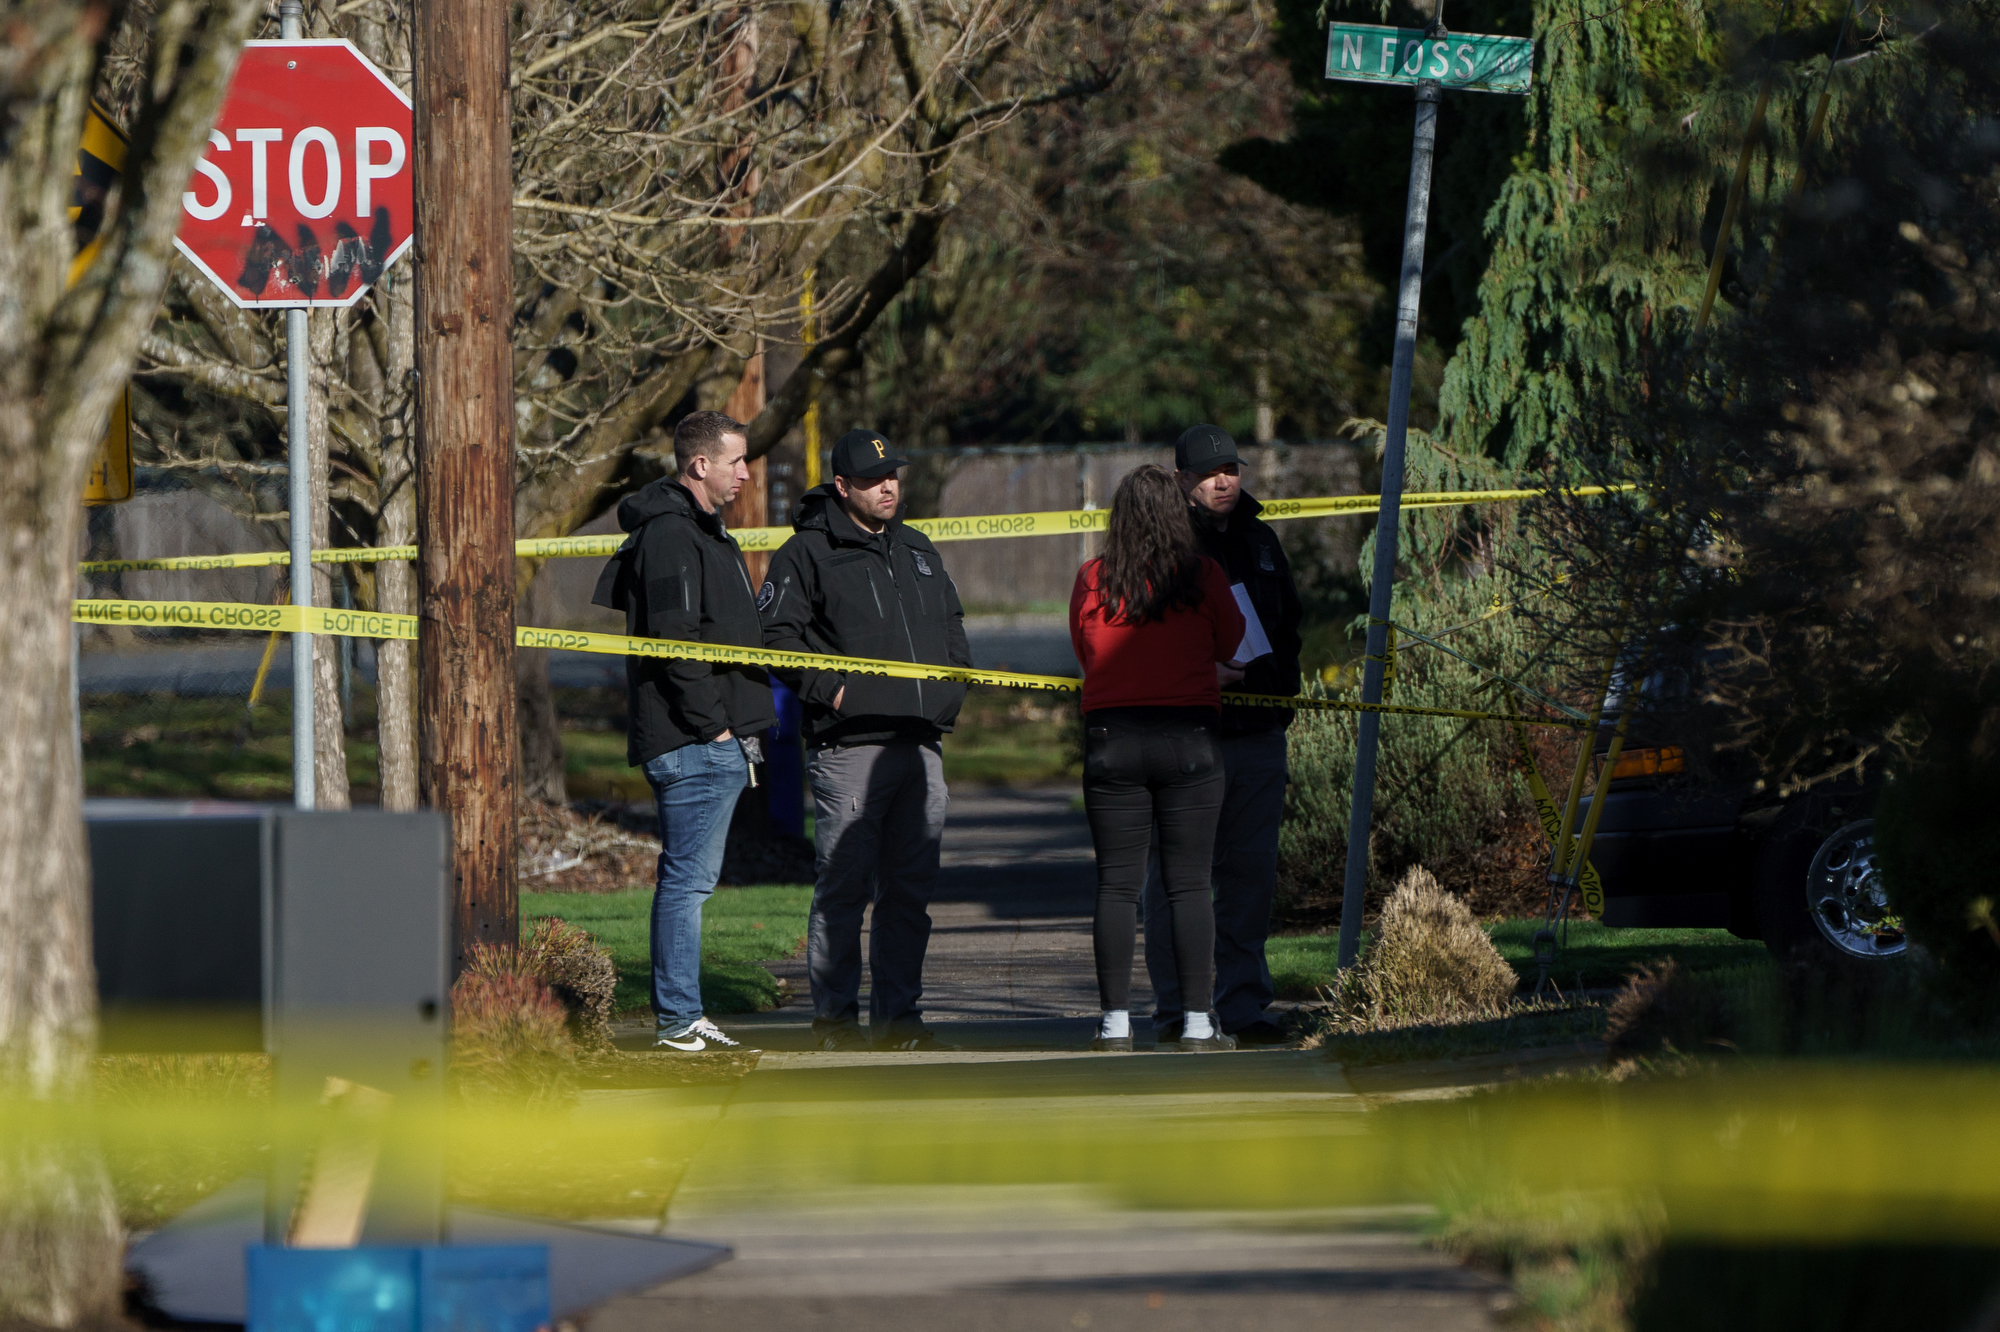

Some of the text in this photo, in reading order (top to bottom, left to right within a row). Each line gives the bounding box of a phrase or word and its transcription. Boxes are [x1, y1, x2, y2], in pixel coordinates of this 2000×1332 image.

[1341, 34, 1363, 70] N
[1380, 37, 1474, 79] FOSS
[182, 126, 406, 221] STOP
[871, 439, 885, 459] P
